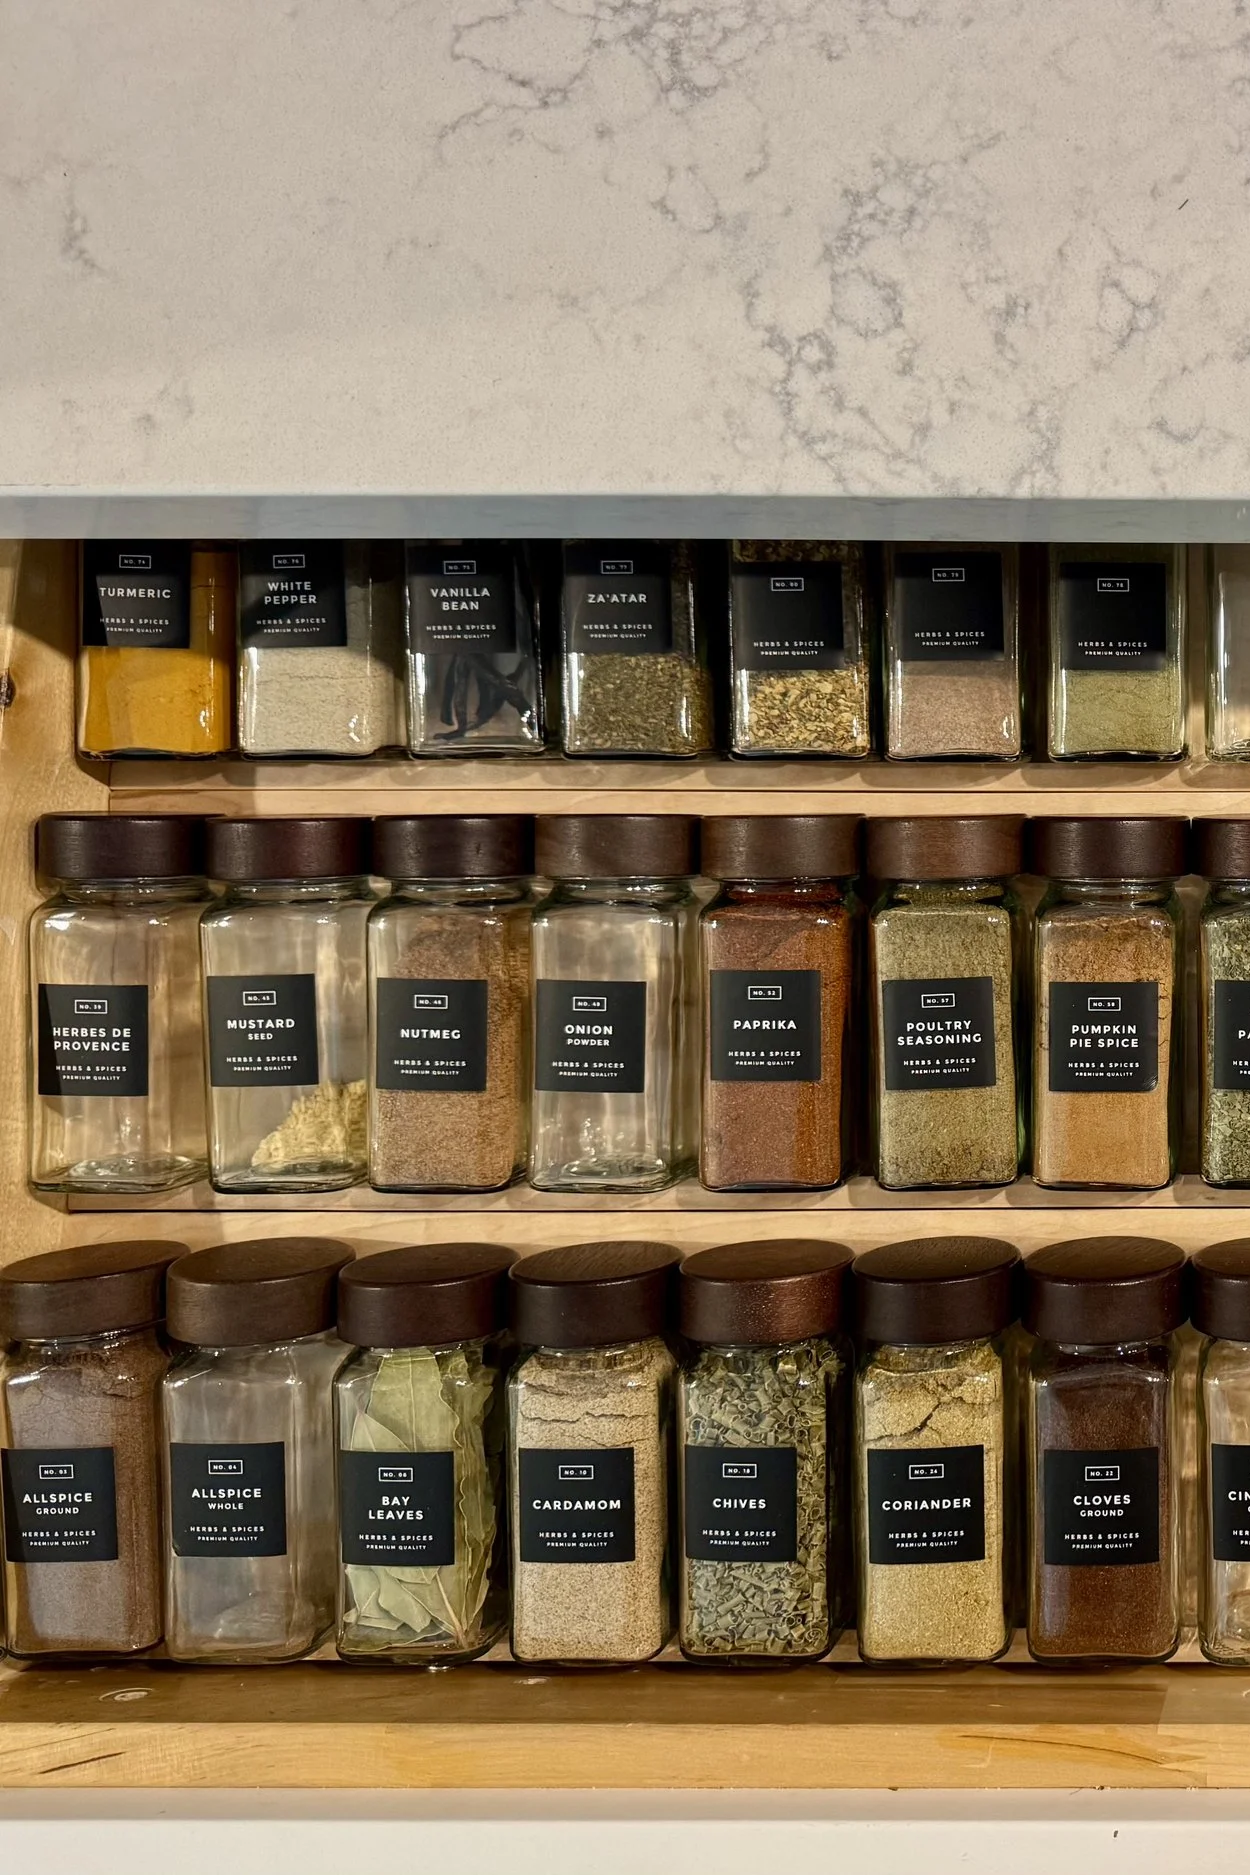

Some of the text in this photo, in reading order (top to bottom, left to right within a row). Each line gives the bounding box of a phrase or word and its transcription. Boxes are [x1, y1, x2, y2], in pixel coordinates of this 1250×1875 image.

[266, 581, 313, 591] WHITE
[98, 587, 172, 599] TURMERIC
[429, 587, 492, 598] VANILLA
[263, 594, 318, 605] PEPPER
[586, 593, 648, 603] ZA'ATAR
[440, 601, 480, 611] BEAN
[255, 616, 327, 626] HERBS & SPICES
[752, 640, 826, 648] HERBS & SPICES
[1077, 640, 1149, 649] HERBS & SPICES
[1084, 649, 1113, 657] PREMIUM
[753, 989, 776, 997] NO. 52
[926, 997, 939, 1005] NO.
[226, 1018, 296, 1029] MUSTARD
[732, 1020, 798, 1030] PAPRIKA
[905, 1020, 972, 1032] POULTRY
[52, 1027, 132, 1038] HERBES DE
[399, 1028, 462, 1039] NUTMEG
[563, 1024, 614, 1035] ONION
[1071, 1024, 1137, 1034] PUMPKIN
[246, 1033, 274, 1041] SEED
[896, 1033, 983, 1046] SEASONING
[53, 1040, 131, 1052] PROVENCE
[565, 1038, 611, 1047] POWDER
[1069, 1038, 1140, 1048] PIE SPICE
[727, 1050, 802, 1058] HERBS & SPICES
[54, 1064, 128, 1073] HERBS & SPICES
[1067, 1061, 1140, 1069] HERBS & SPICES
[728, 1467, 740, 1475] NO.
[914, 1467, 938, 1476] NO. 24
[1090, 1470, 1103, 1478] NO.
[21, 1492, 93, 1503] ALLSPICE
[190, 1488, 263, 1499] ALLSPICE
[381, 1496, 411, 1506] BAY
[531, 1499, 622, 1510] CARDAMOM
[711, 1498, 767, 1509] CHIVES
[881, 1497, 972, 1511] CORIANDER
[1072, 1494, 1132, 1506] CLOVES
[35, 1507, 80, 1516] GROUND
[207, 1502, 245, 1511] WHOLE
[367, 1509, 425, 1520] LEAVES
[1079, 1509, 1125, 1518] GROUND
[21, 1529, 97, 1538] HERBS & SPICES
[358, 1533, 434, 1542] HERBS & SPICES
[538, 1530, 615, 1539] HERBS & SPICES
[887, 1529, 966, 1540] HERBS & SPICES
